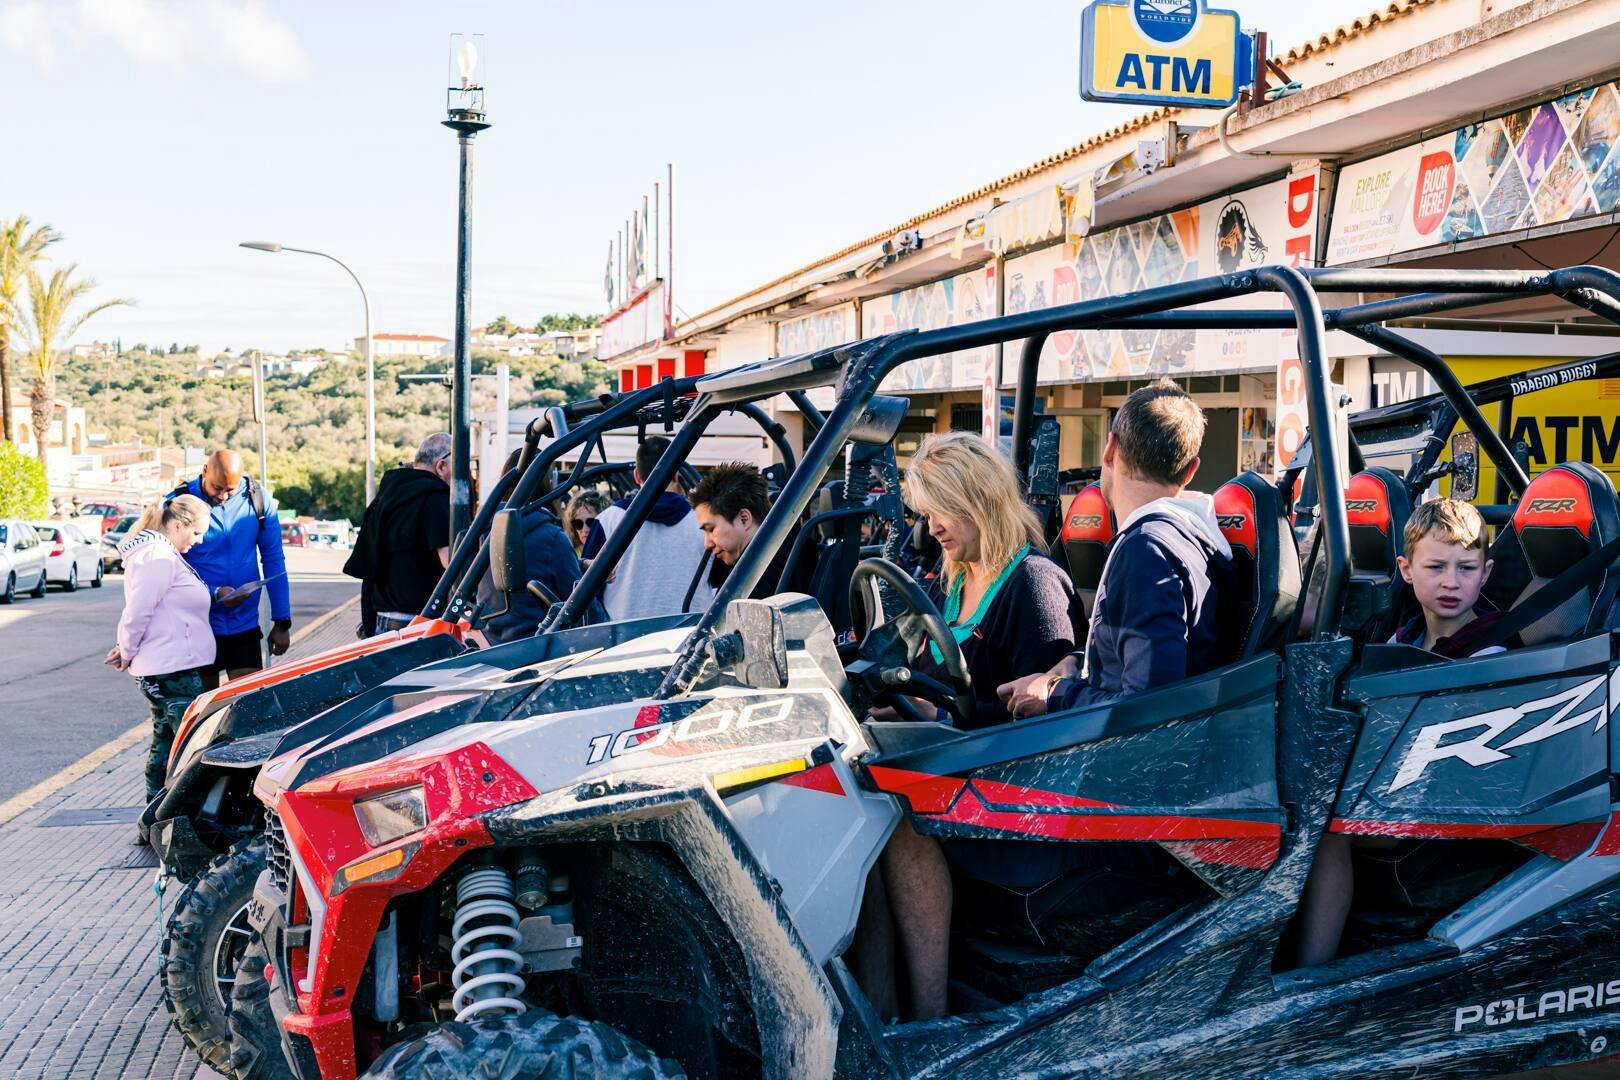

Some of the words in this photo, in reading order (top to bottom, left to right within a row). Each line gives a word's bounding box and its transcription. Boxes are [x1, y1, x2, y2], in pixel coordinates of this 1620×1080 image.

[1140, 14, 1192, 23] WORLDWIDE
[1116, 53, 1211, 94] ATM
[1356, 170, 1391, 196] EXPLORE
[1423, 163, 1451, 194] BOOK
[1418, 189, 1447, 218] HERE!
[1510, 374, 1558, 396] DRAGON
[1559, 362, 1597, 383] BUGGY
[1509, 416, 1620, 464] ATM
[1525, 498, 1577, 514] RZR
[1069, 514, 1104, 529] RZR
[1216, 514, 1246, 530] ZR
[587, 697, 794, 766] 1000
[1454, 980, 1620, 1032] POLARIS
